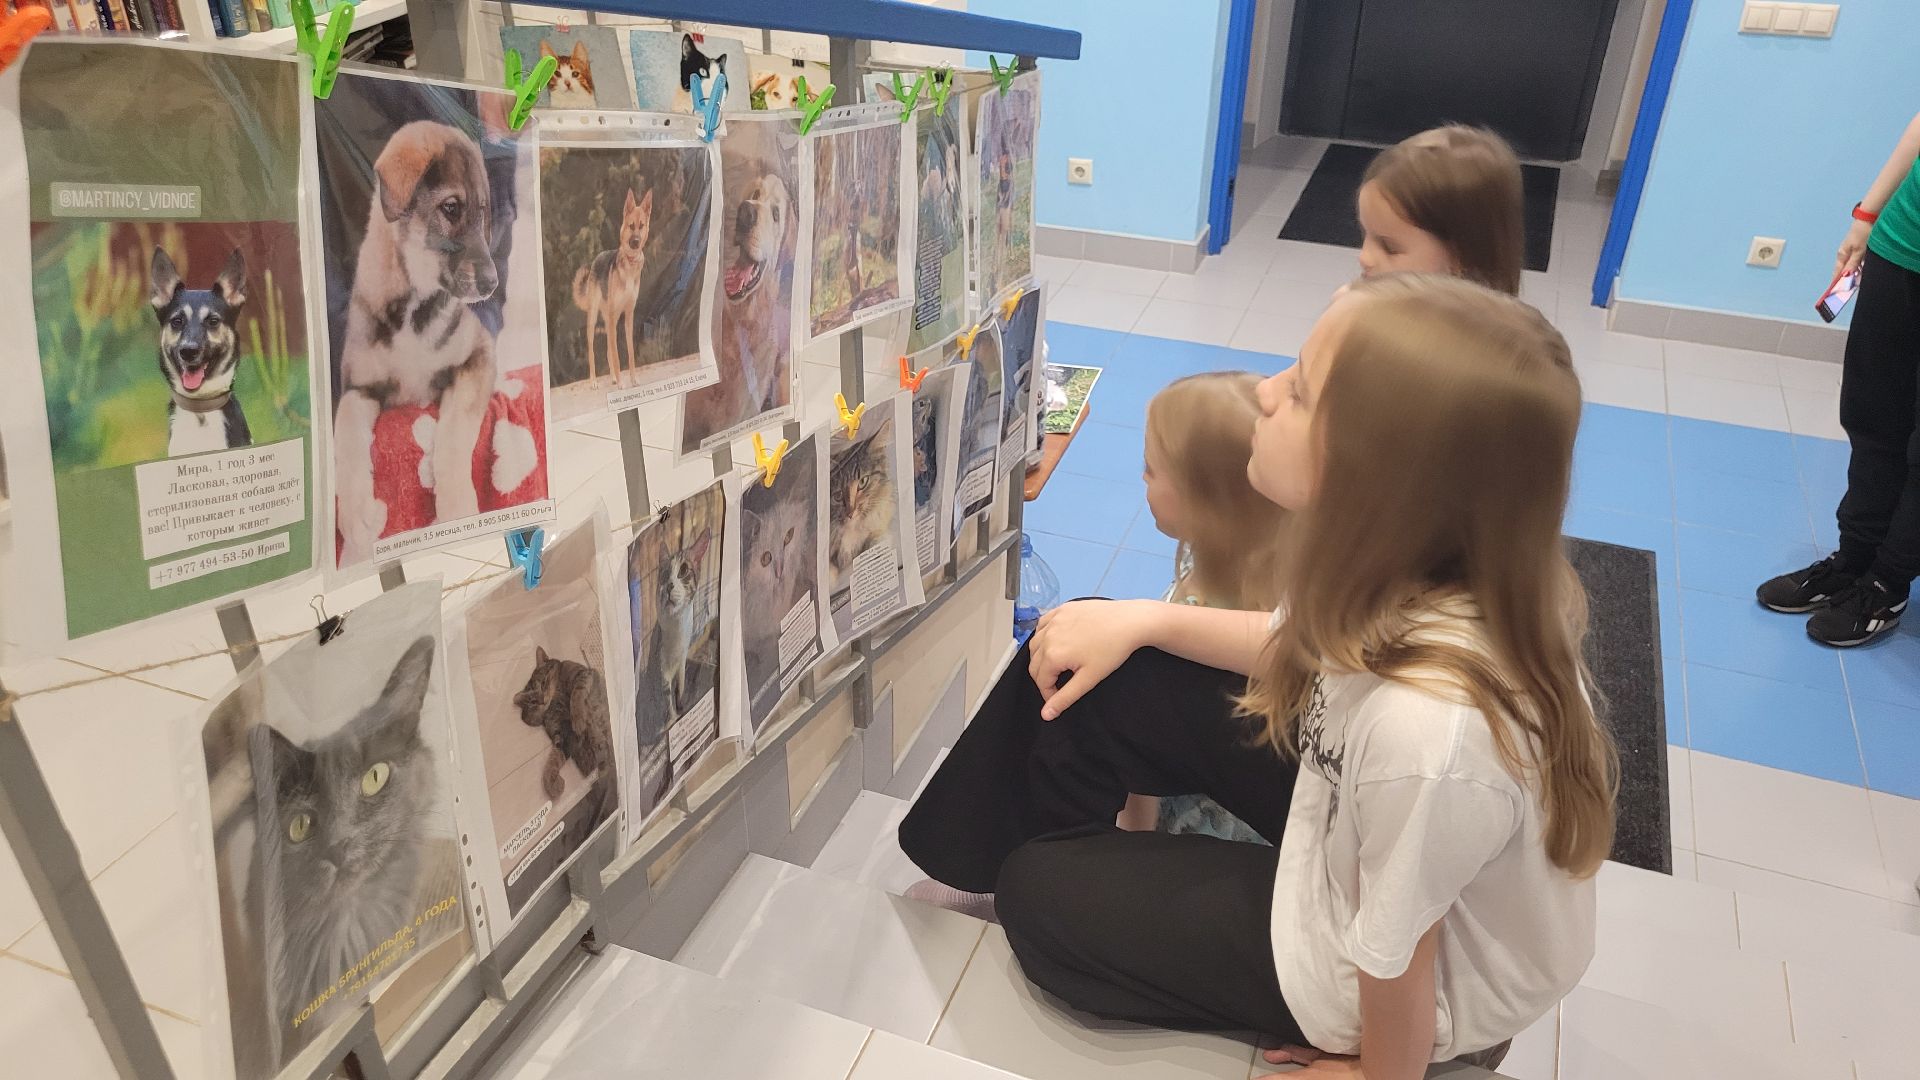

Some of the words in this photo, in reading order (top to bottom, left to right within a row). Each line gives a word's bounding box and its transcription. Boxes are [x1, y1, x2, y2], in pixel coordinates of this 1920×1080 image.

[59, 189, 196, 211] @MARTINCY_VIDNOE
[177, 464, 213, 478] Мира,
[217, 460, 222, 471] 1
[228, 457, 246, 470] год
[248, 454, 255, 465] 3
[147, 493, 238, 518] стерилизованая
[241, 484, 275, 499] собака
[278, 479, 300, 492] ждёт
[168, 479, 229, 495] Ласковая,
[147, 518, 170, 535] вас!
[173, 510, 236, 530] Привыкает
[239, 506, 245, 515] к
[249, 496, 295, 513] человеку,
[187, 525, 235, 542] которым
[238, 517, 271, 531] живет
[423, 531, 434, 542] 3,5
[434, 525, 462, 538] месяца,
[463, 521, 477, 531] тел.
[478, 518, 483, 528] 8
[511, 510, 520, 521] 11
[530, 504, 553, 517] Ольга
[155, 568, 173, 583] +7
[177, 561, 196, 576] 977
[199, 548, 254, 570] 494-53-50
[257, 541, 286, 556] Ирина
[293, 984, 338, 1029] КОШКА
[415, 915, 423, 926] 4
[424, 895, 458, 921] ГОДА
